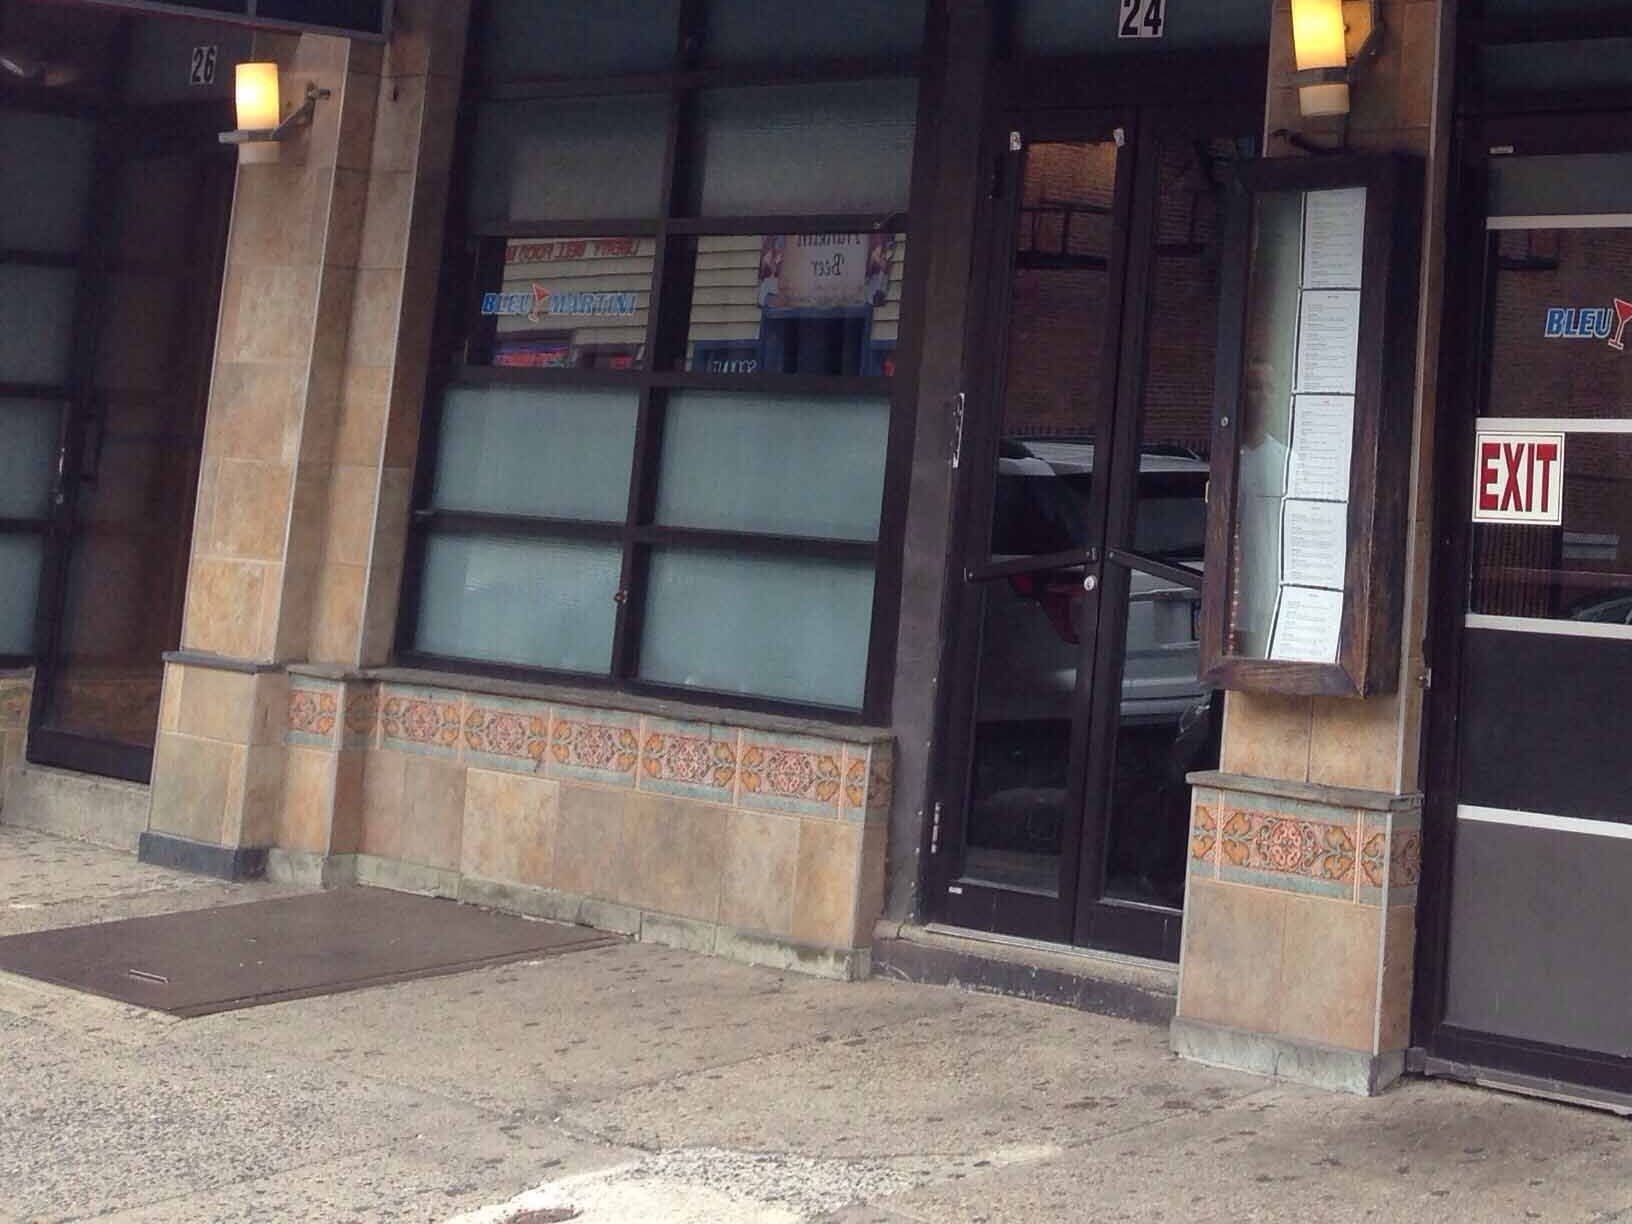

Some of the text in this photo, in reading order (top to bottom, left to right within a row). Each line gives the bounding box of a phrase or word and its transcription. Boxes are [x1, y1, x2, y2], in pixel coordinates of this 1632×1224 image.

[191, 48, 216, 84] 26
[481, 292, 637, 316] BLEU MARTINI
[1544, 307, 1612, 338] BLEU
[1479, 442, 1558, 513] EXIT
